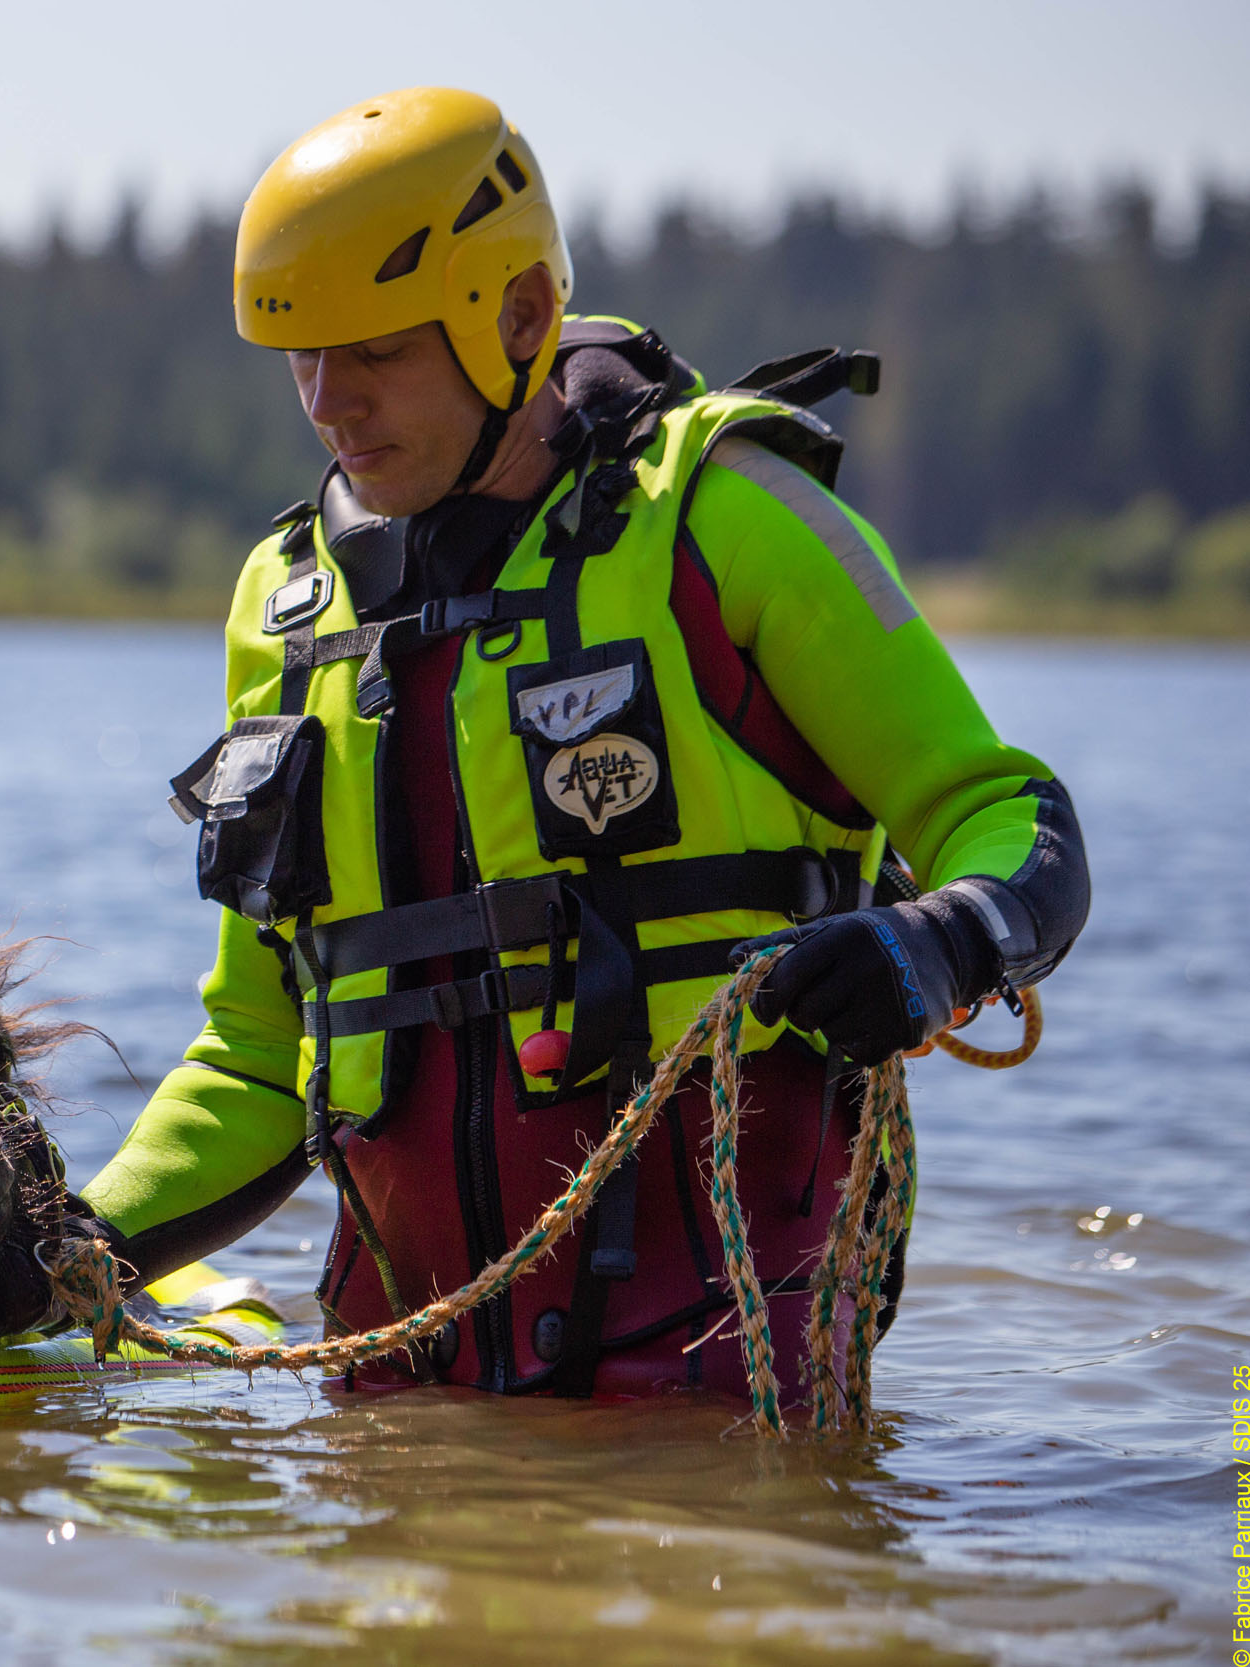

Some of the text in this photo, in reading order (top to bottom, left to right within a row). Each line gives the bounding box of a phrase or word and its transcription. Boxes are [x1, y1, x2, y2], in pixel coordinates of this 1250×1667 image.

[537, 688, 600, 728] VPL
[558, 746, 646, 795] AQUA
[581, 772, 637, 822] VET
[875, 924, 926, 1018] BARE
